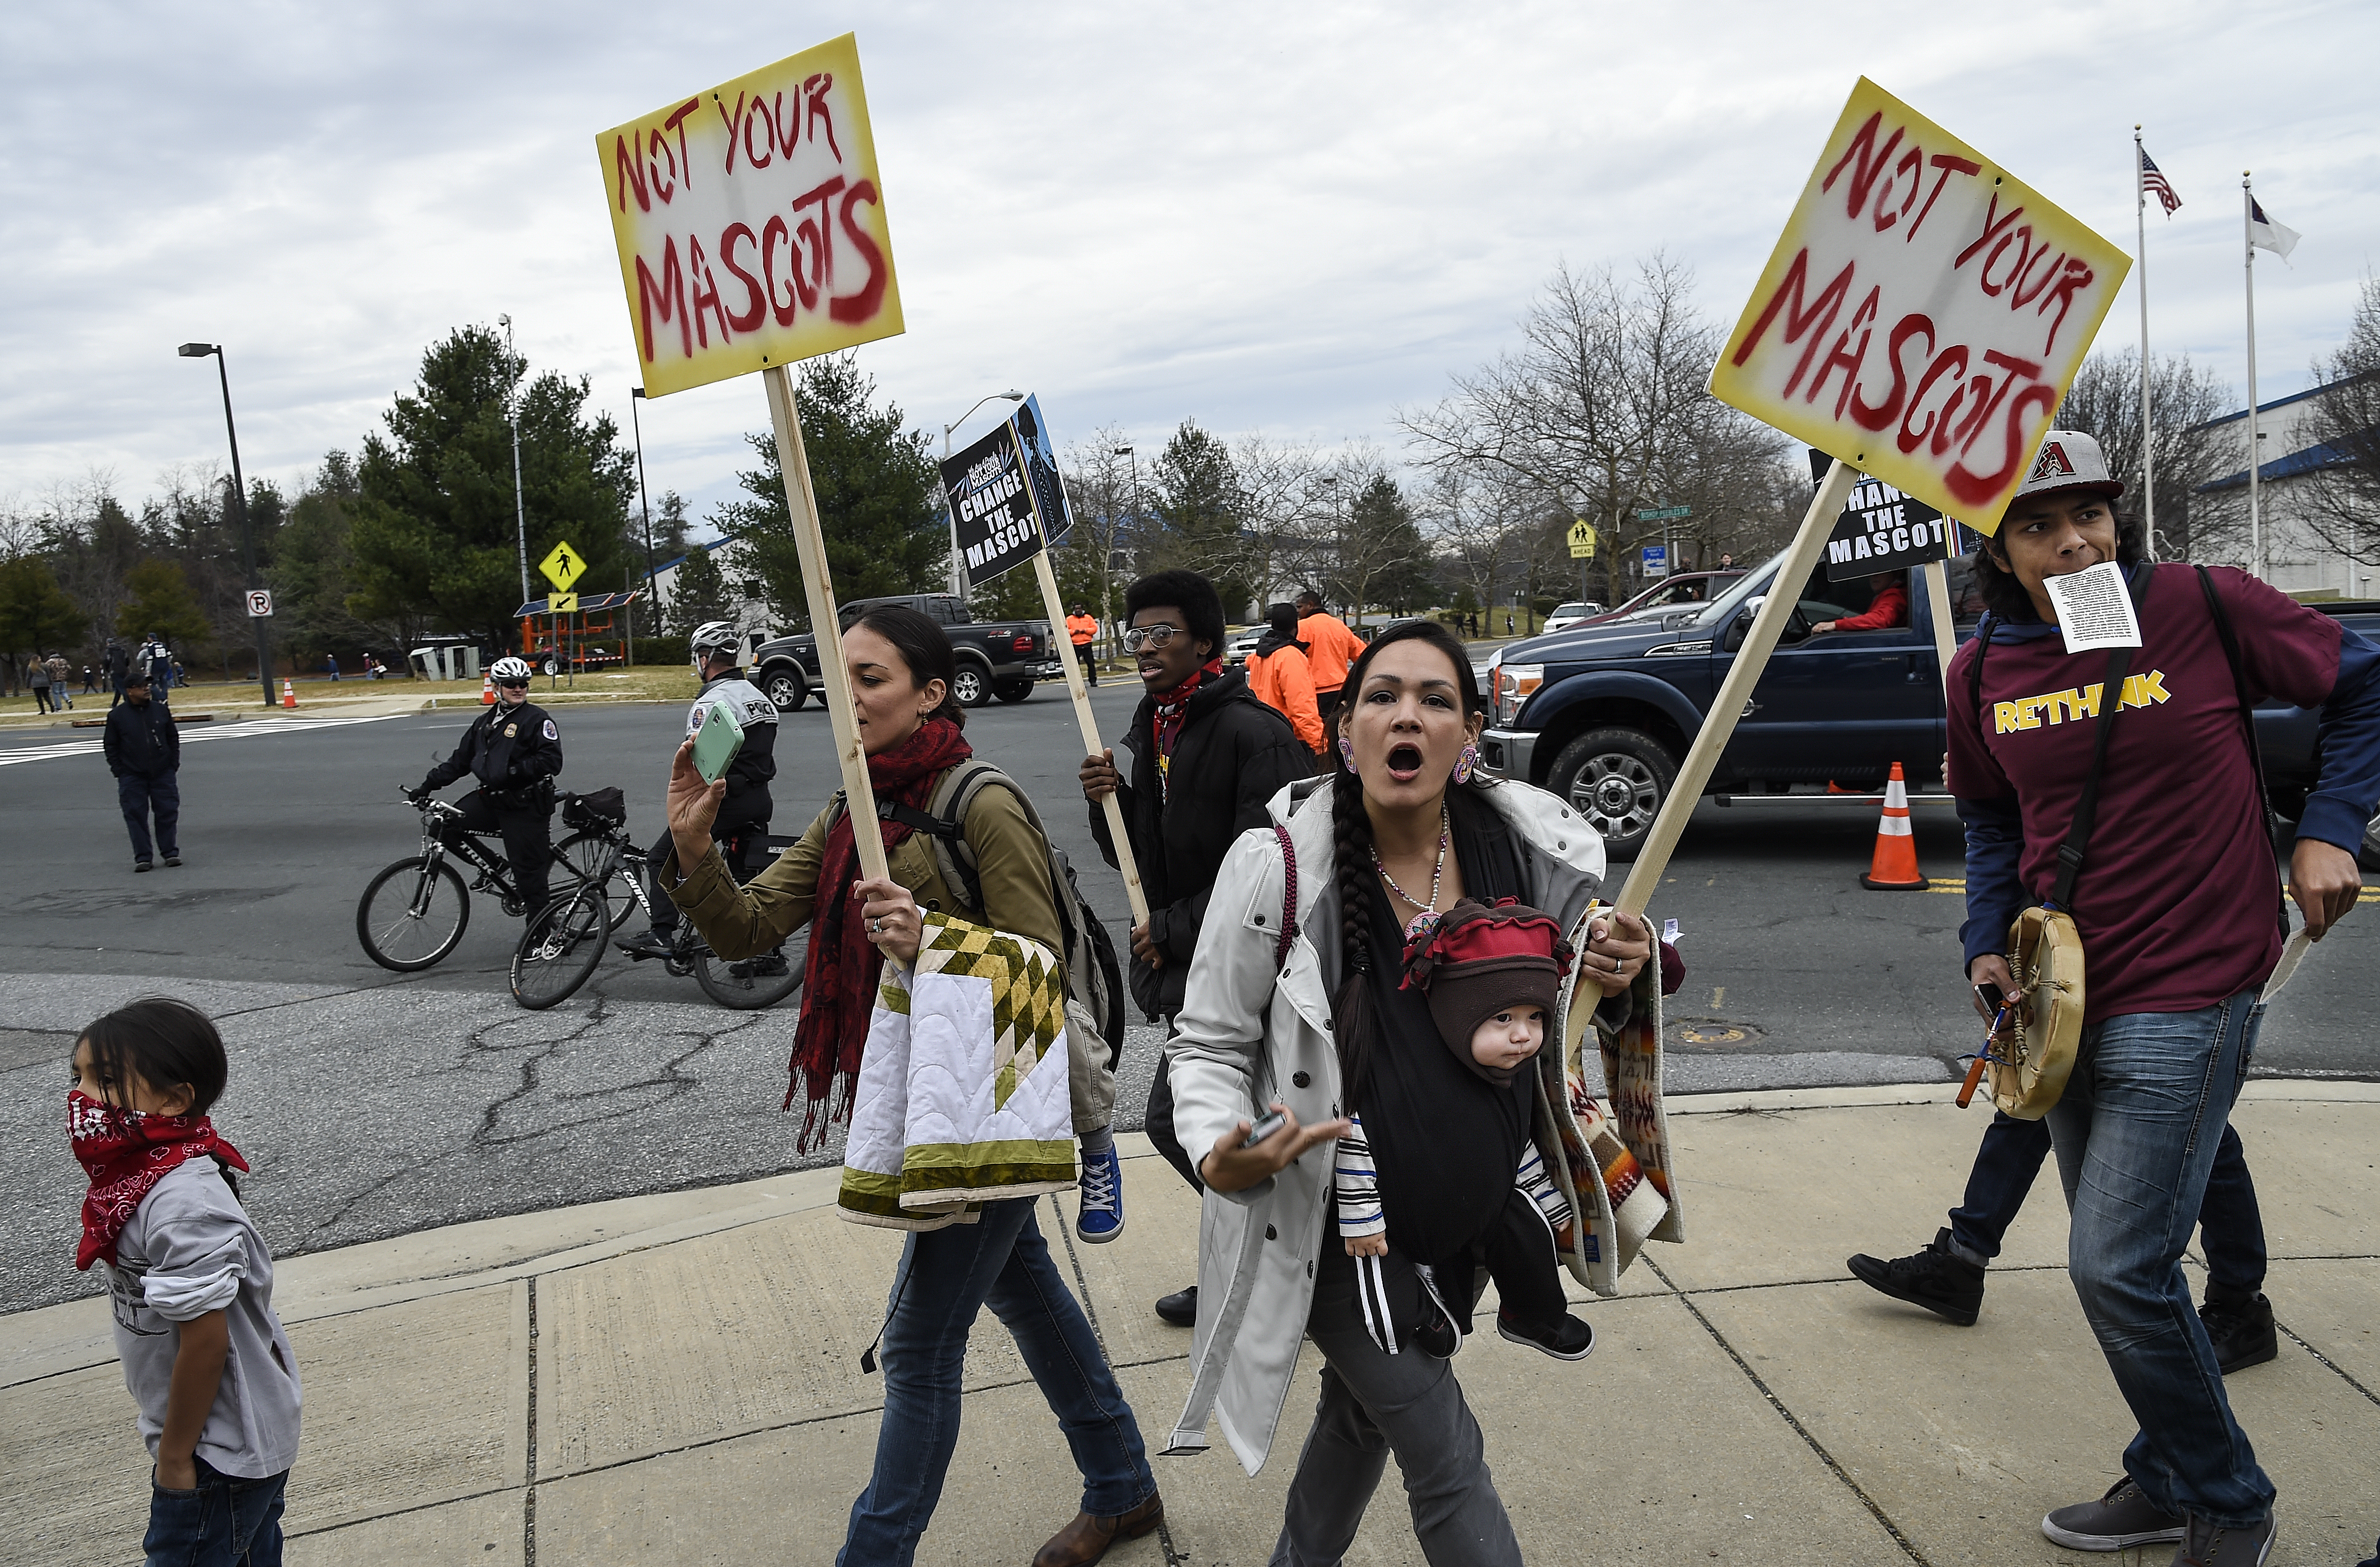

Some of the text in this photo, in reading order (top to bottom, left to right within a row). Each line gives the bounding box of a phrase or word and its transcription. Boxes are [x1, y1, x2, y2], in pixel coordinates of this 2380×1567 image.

[617, 73, 841, 214] NOT YOUR
[1822, 111, 2093, 356] NOT YOUR
[636, 175, 887, 362] MASCOTS
[1731, 247, 2057, 508] MASCOTS
[968, 457, 1000, 481] NOT YOUR
[971, 465, 1002, 489] MASCOTS
[960, 468, 1022, 522] CHANGE
[966, 511, 1039, 570] MASCOT
[984, 503, 1014, 534] THE
[1862, 505, 1907, 532] THE
[1829, 519, 1943, 564] MASCOT
[746, 702, 775, 716] POCE
[460, 841, 496, 875] TREK
